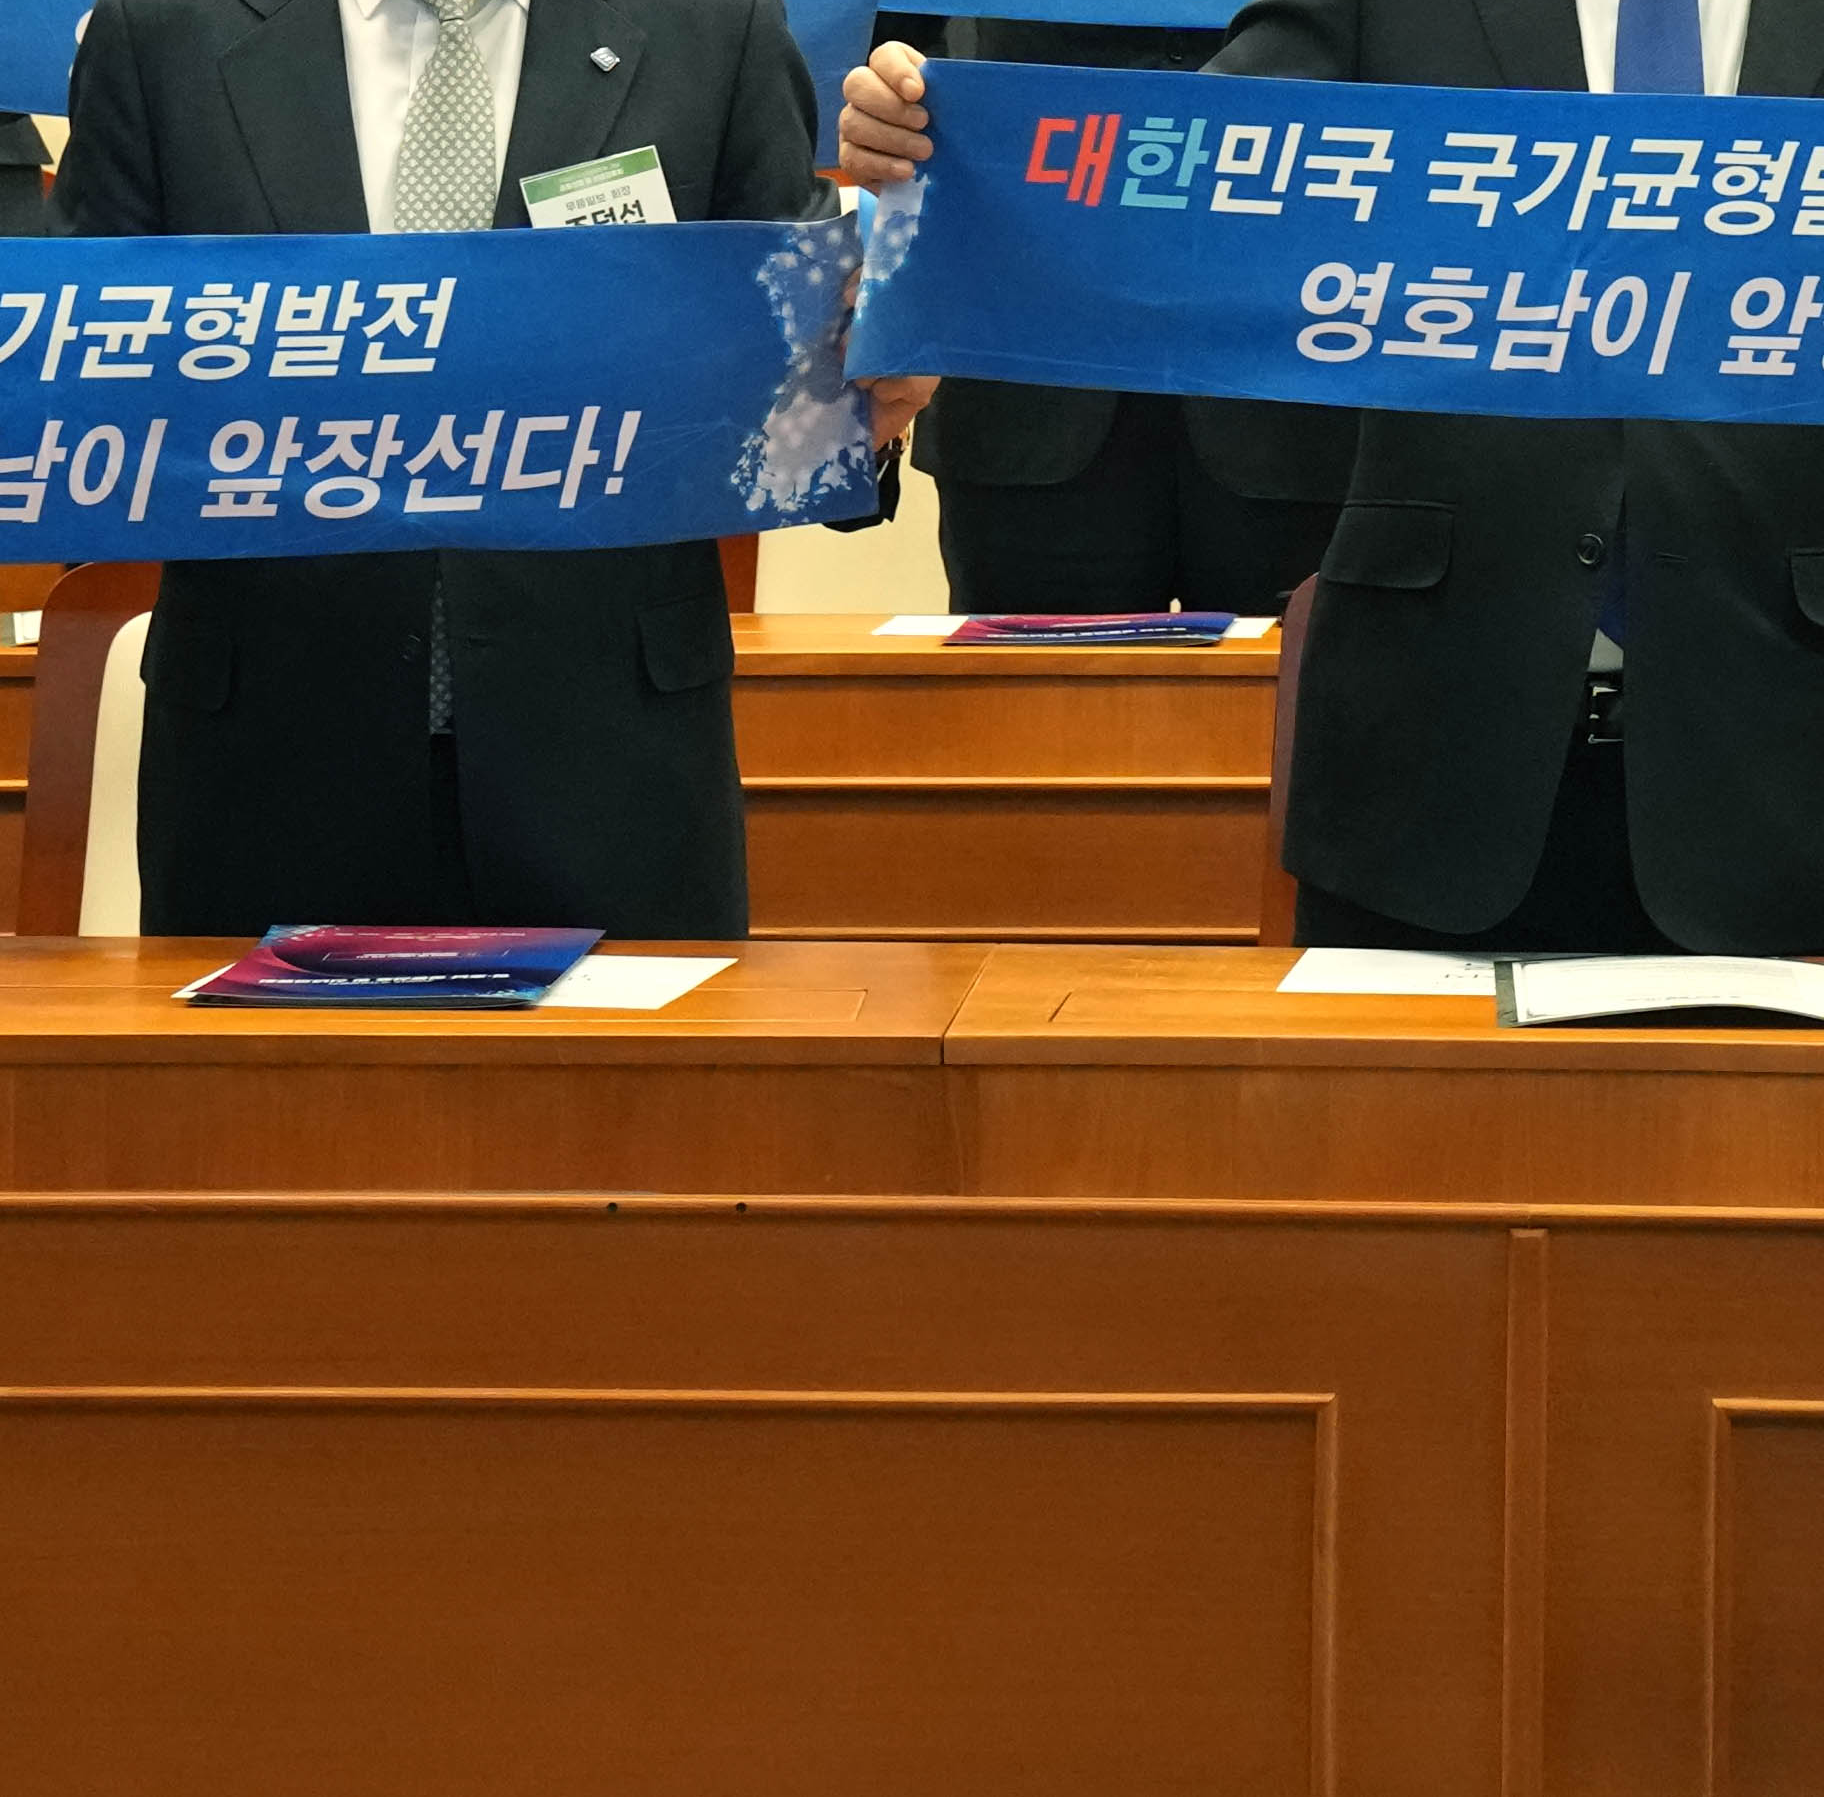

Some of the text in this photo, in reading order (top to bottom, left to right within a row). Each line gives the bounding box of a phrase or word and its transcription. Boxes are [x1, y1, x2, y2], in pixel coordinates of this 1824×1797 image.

[1025, 114, 1395, 223] 대한민국
[1295, 261, 1684, 374] 영호남이
[199, 405, 643, 520] 앞장선다!
